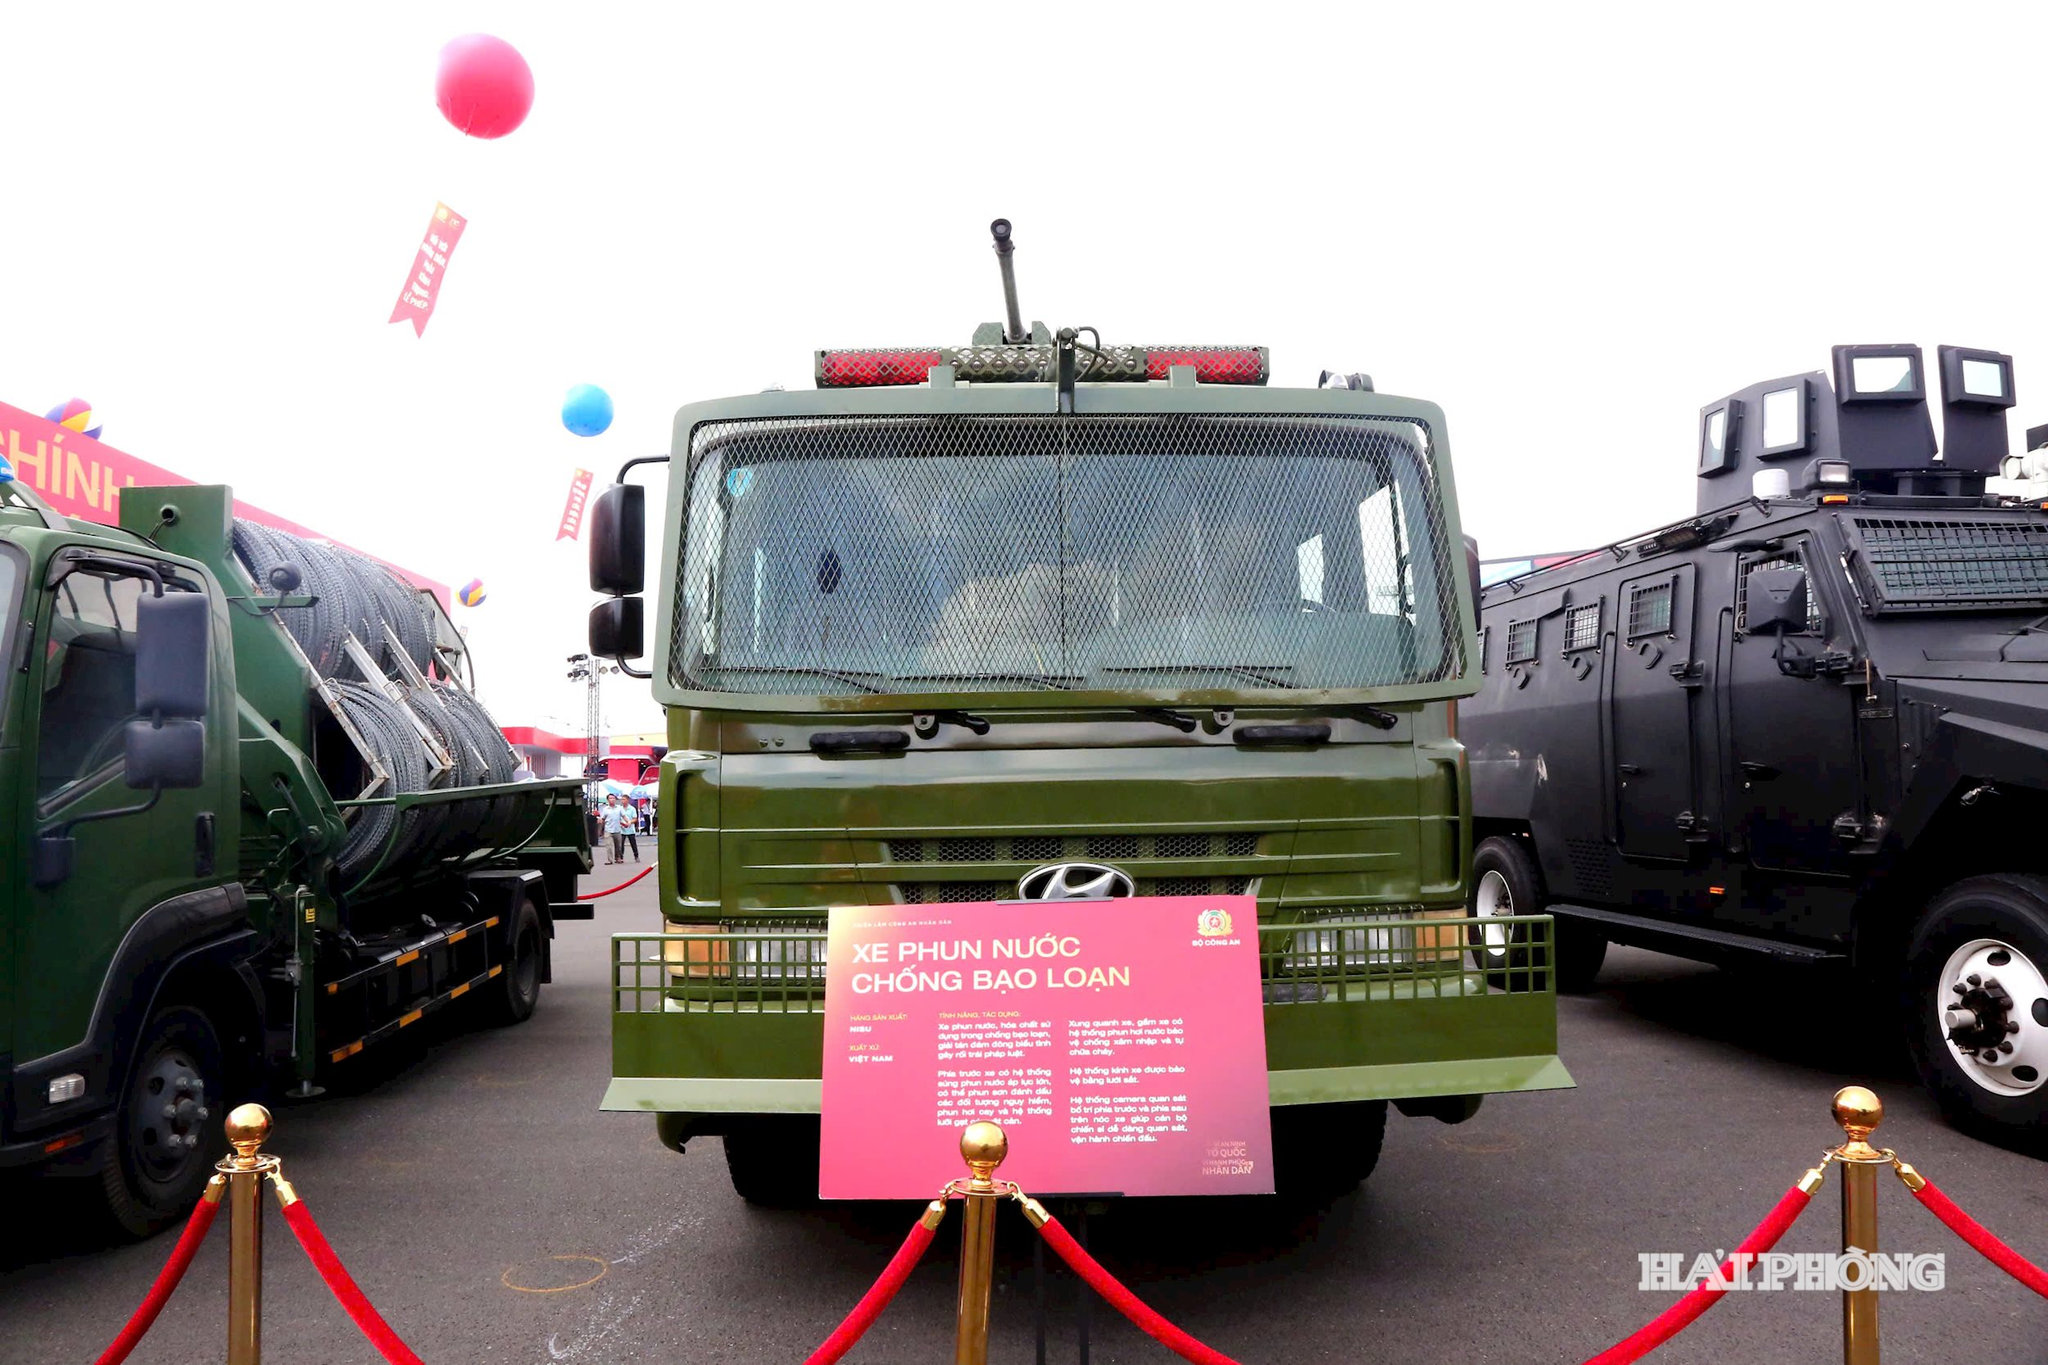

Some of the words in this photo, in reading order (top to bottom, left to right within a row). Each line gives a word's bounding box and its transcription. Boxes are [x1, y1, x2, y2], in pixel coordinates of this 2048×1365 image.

[0, 429, 134, 513] HÍNH
[852, 943, 888, 963] XE
[899, 940, 982, 962] PHUN
[992, 932, 1080, 959] NƯỚC
[852, 964, 962, 994] CHỐNG
[973, 969, 1037, 994] BẠO
[1048, 966, 1130, 992] LOẠN
[849, 1055, 869, 1063] VIỆT
